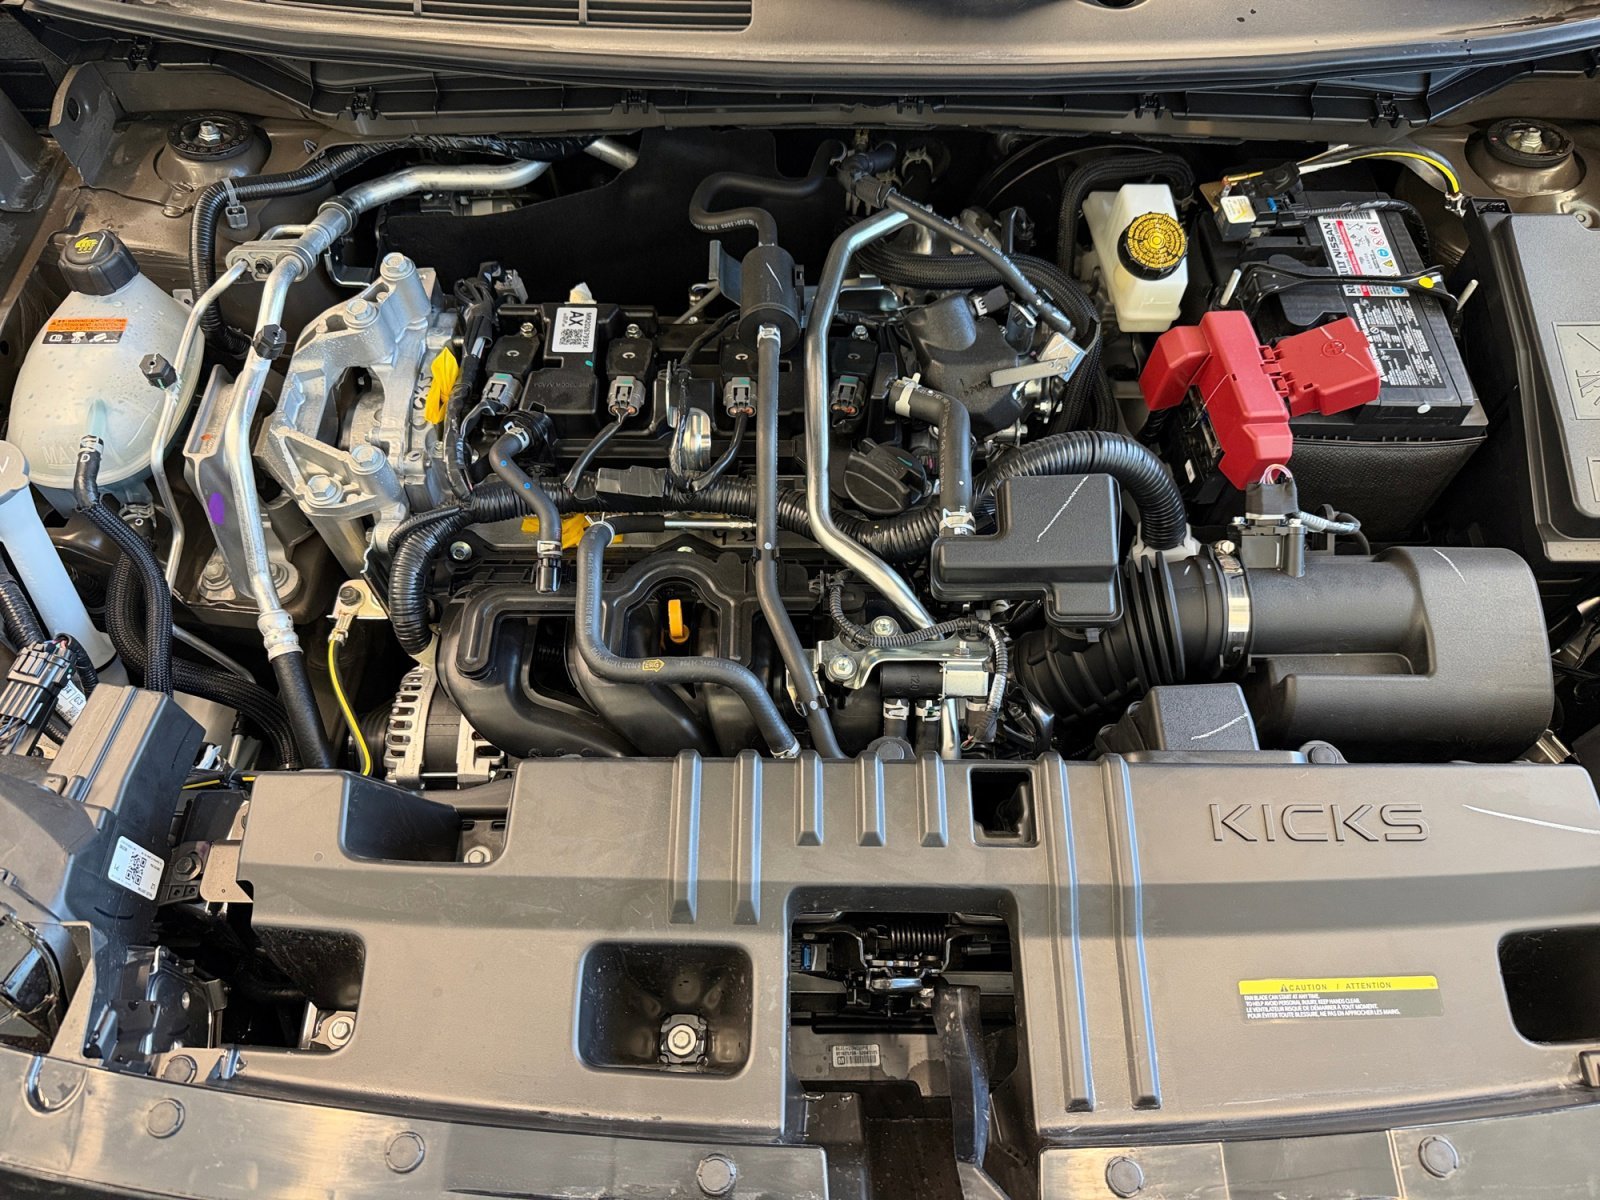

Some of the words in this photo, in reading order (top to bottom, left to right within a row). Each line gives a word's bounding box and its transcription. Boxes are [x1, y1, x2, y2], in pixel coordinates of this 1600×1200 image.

[1322, 222, 1343, 258] NISSAN
[568, 310, 584, 326] AX
[80, 454, 90, 462] D
[1209, 804, 1430, 842] KICKS
